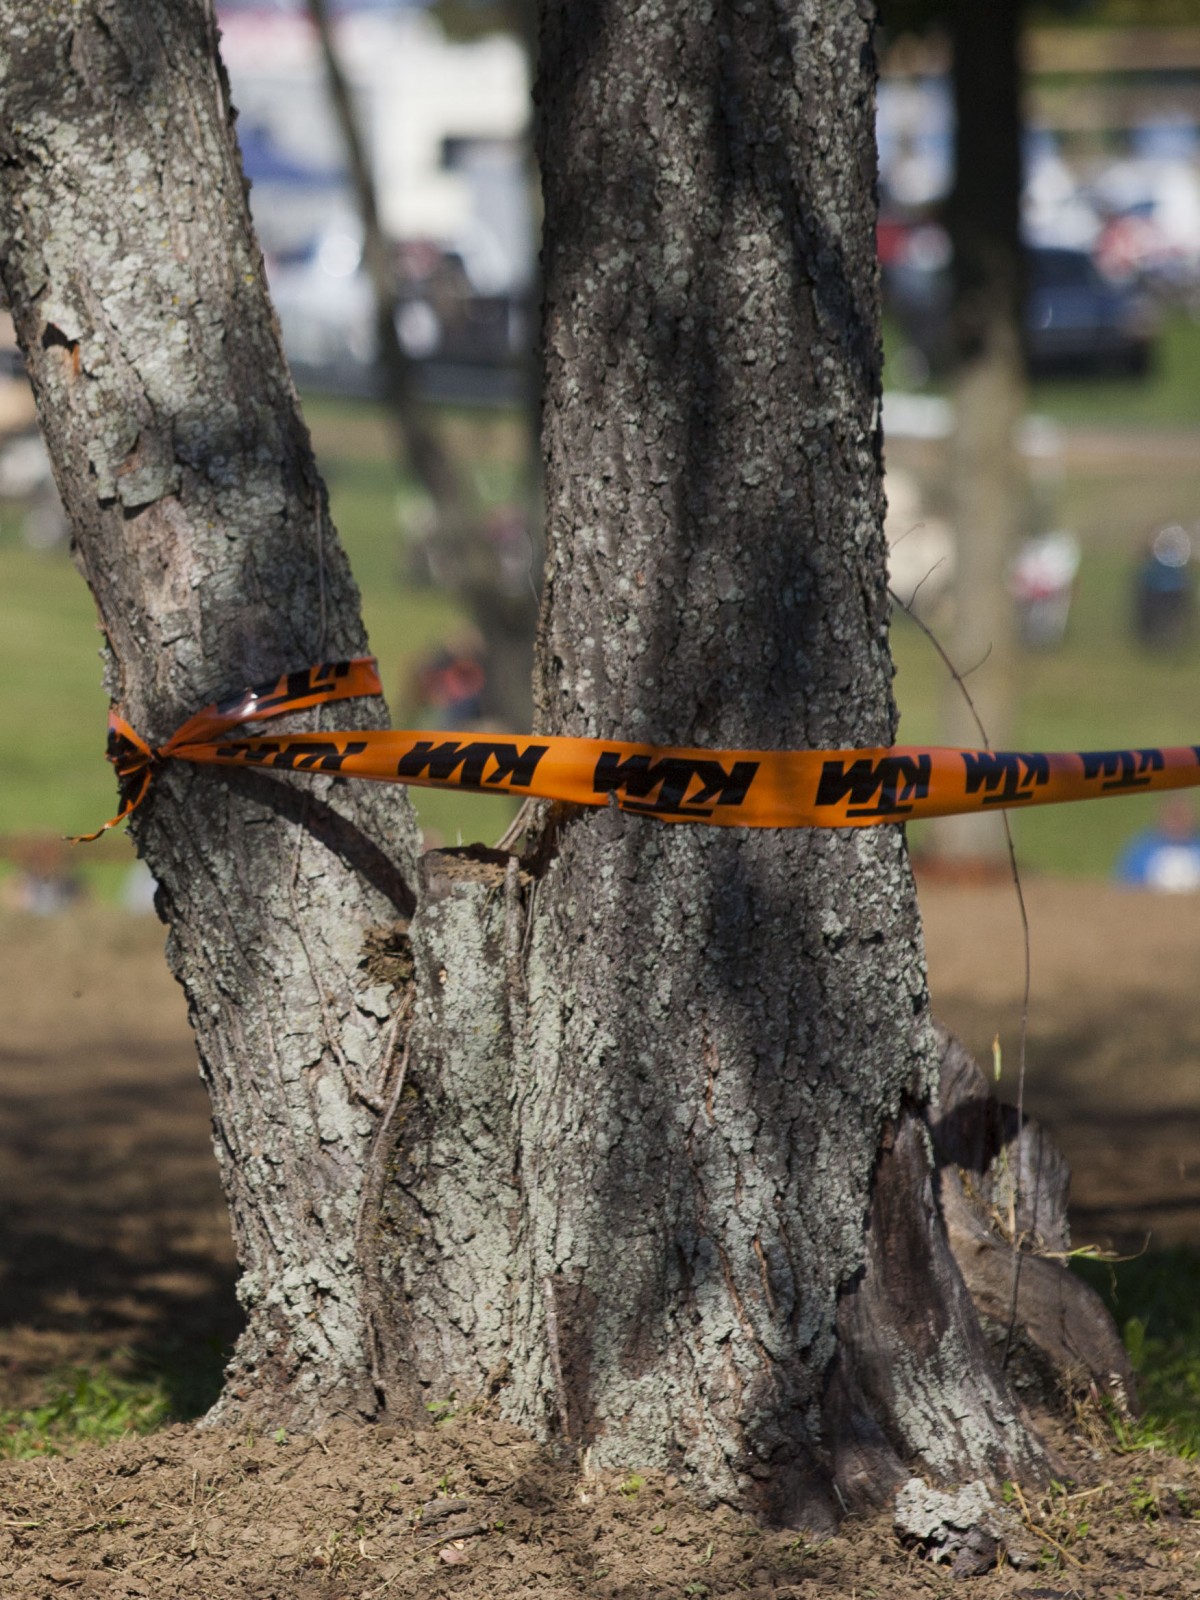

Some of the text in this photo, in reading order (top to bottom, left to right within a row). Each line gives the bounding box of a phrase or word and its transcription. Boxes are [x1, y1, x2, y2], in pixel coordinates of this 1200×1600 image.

[397, 741, 549, 794] KTM
[592, 751, 760, 818] KTM
[814, 753, 932, 818] KTM
[960, 753, 1050, 804] KTM
[1079, 749, 1165, 791] KTM
